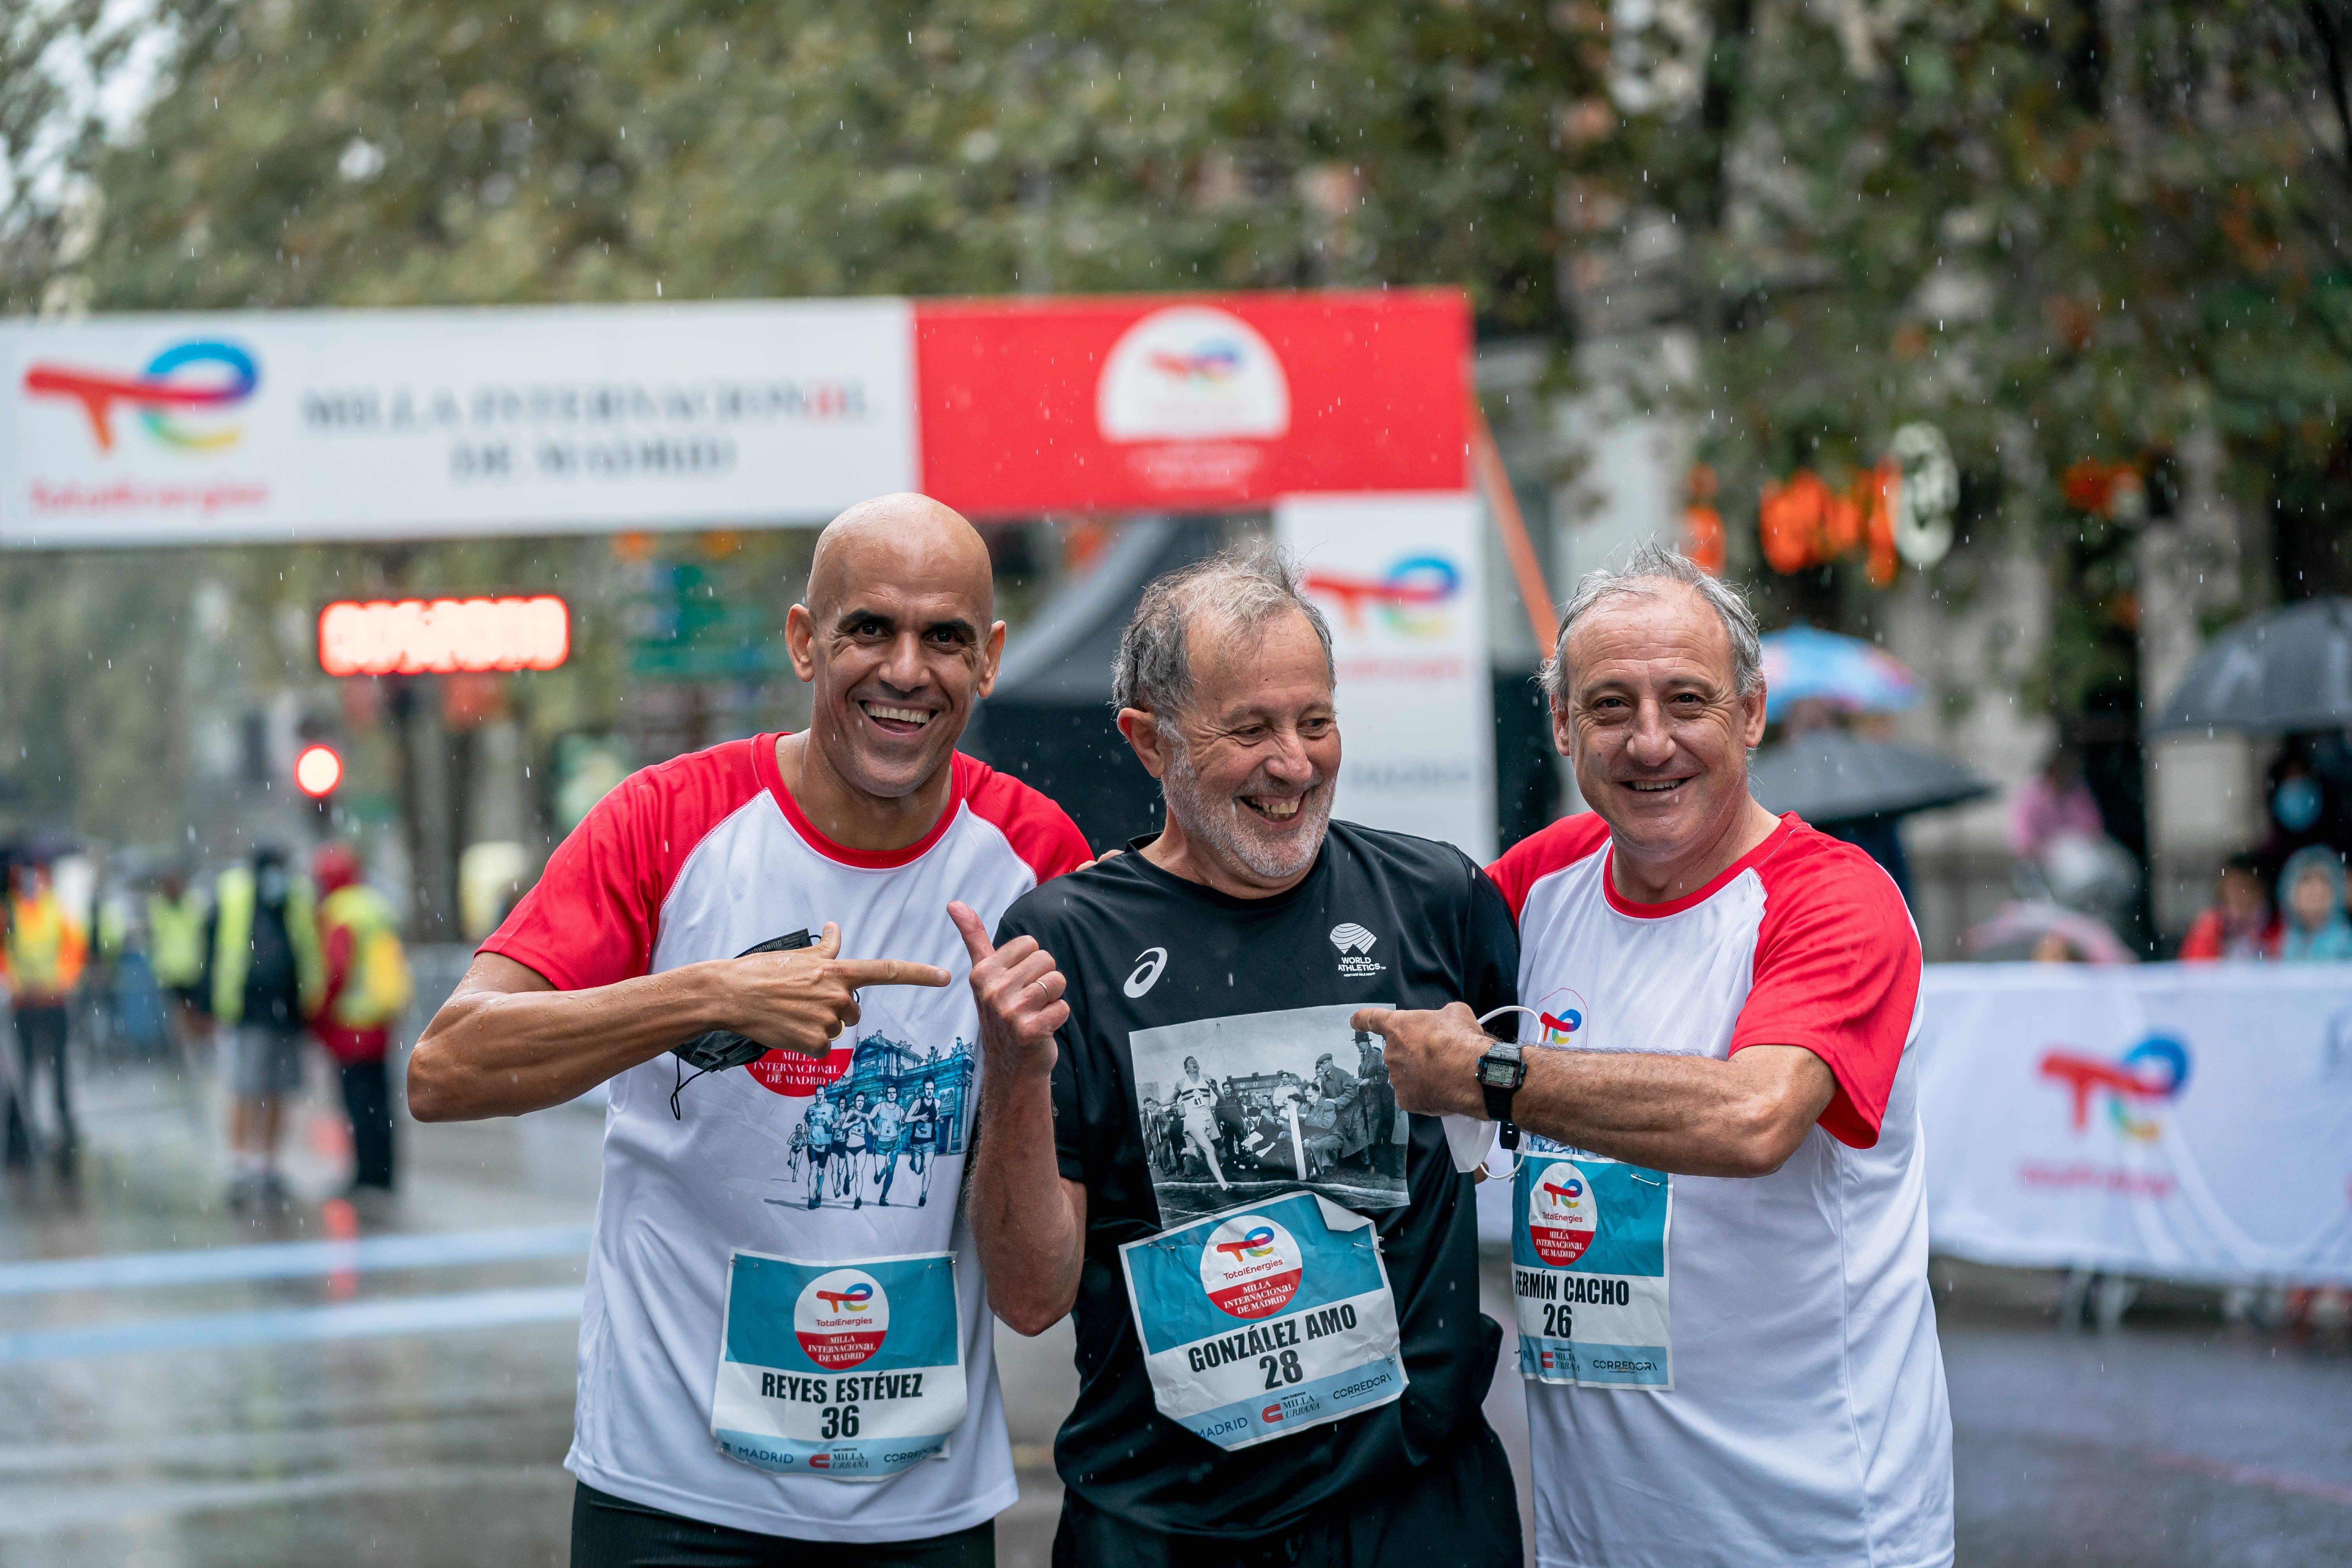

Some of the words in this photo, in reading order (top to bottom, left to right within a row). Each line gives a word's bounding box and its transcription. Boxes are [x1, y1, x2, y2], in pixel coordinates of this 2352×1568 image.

[1338, 963, 1380, 971] ATHLETICS
[782, 1051, 817, 1062] MILL
[766, 1074, 782, 1083] DE
[786, 1074, 826, 1085] MADRID
[1542, 1212, 1583, 1223] TotalEnergies
[1550, 1230, 1569, 1240] MILLA
[1541, 1248, 1550, 1256] DE
[1550, 1249, 1576, 1258] MADRID
[1223, 1259, 1283, 1280] TotalEnergies
[1242, 1280, 1272, 1294] MILLA
[1515, 1270, 1557, 1300] FERMÍN
[1564, 1276, 1629, 1306] CACHO
[1237, 1305, 1250, 1314] DE
[1251, 1295, 1286, 1310] MADRID
[815, 1317, 873, 1327] TotalEnergies
[1543, 1303, 1572, 1338] 26
[830, 1335, 855, 1344] MILLA
[1188, 1319, 1301, 1372] GONZÁLEZ
[1305, 1304, 1357, 1340] AMO
[832, 1352, 865, 1361] MADRID
[1259, 1349, 1303, 1390] 28
[762, 1372, 828, 1404] REYES
[836, 1371, 924, 1403] ESTÉVEZ
[1283, 1394, 1314, 1410] MILLA
[1285, 1402, 1320, 1418] URBANA
[821, 1405, 860, 1439] 36
[739, 1446, 794, 1464] MADRID
[833, 1452, 865, 1461] MILLA
